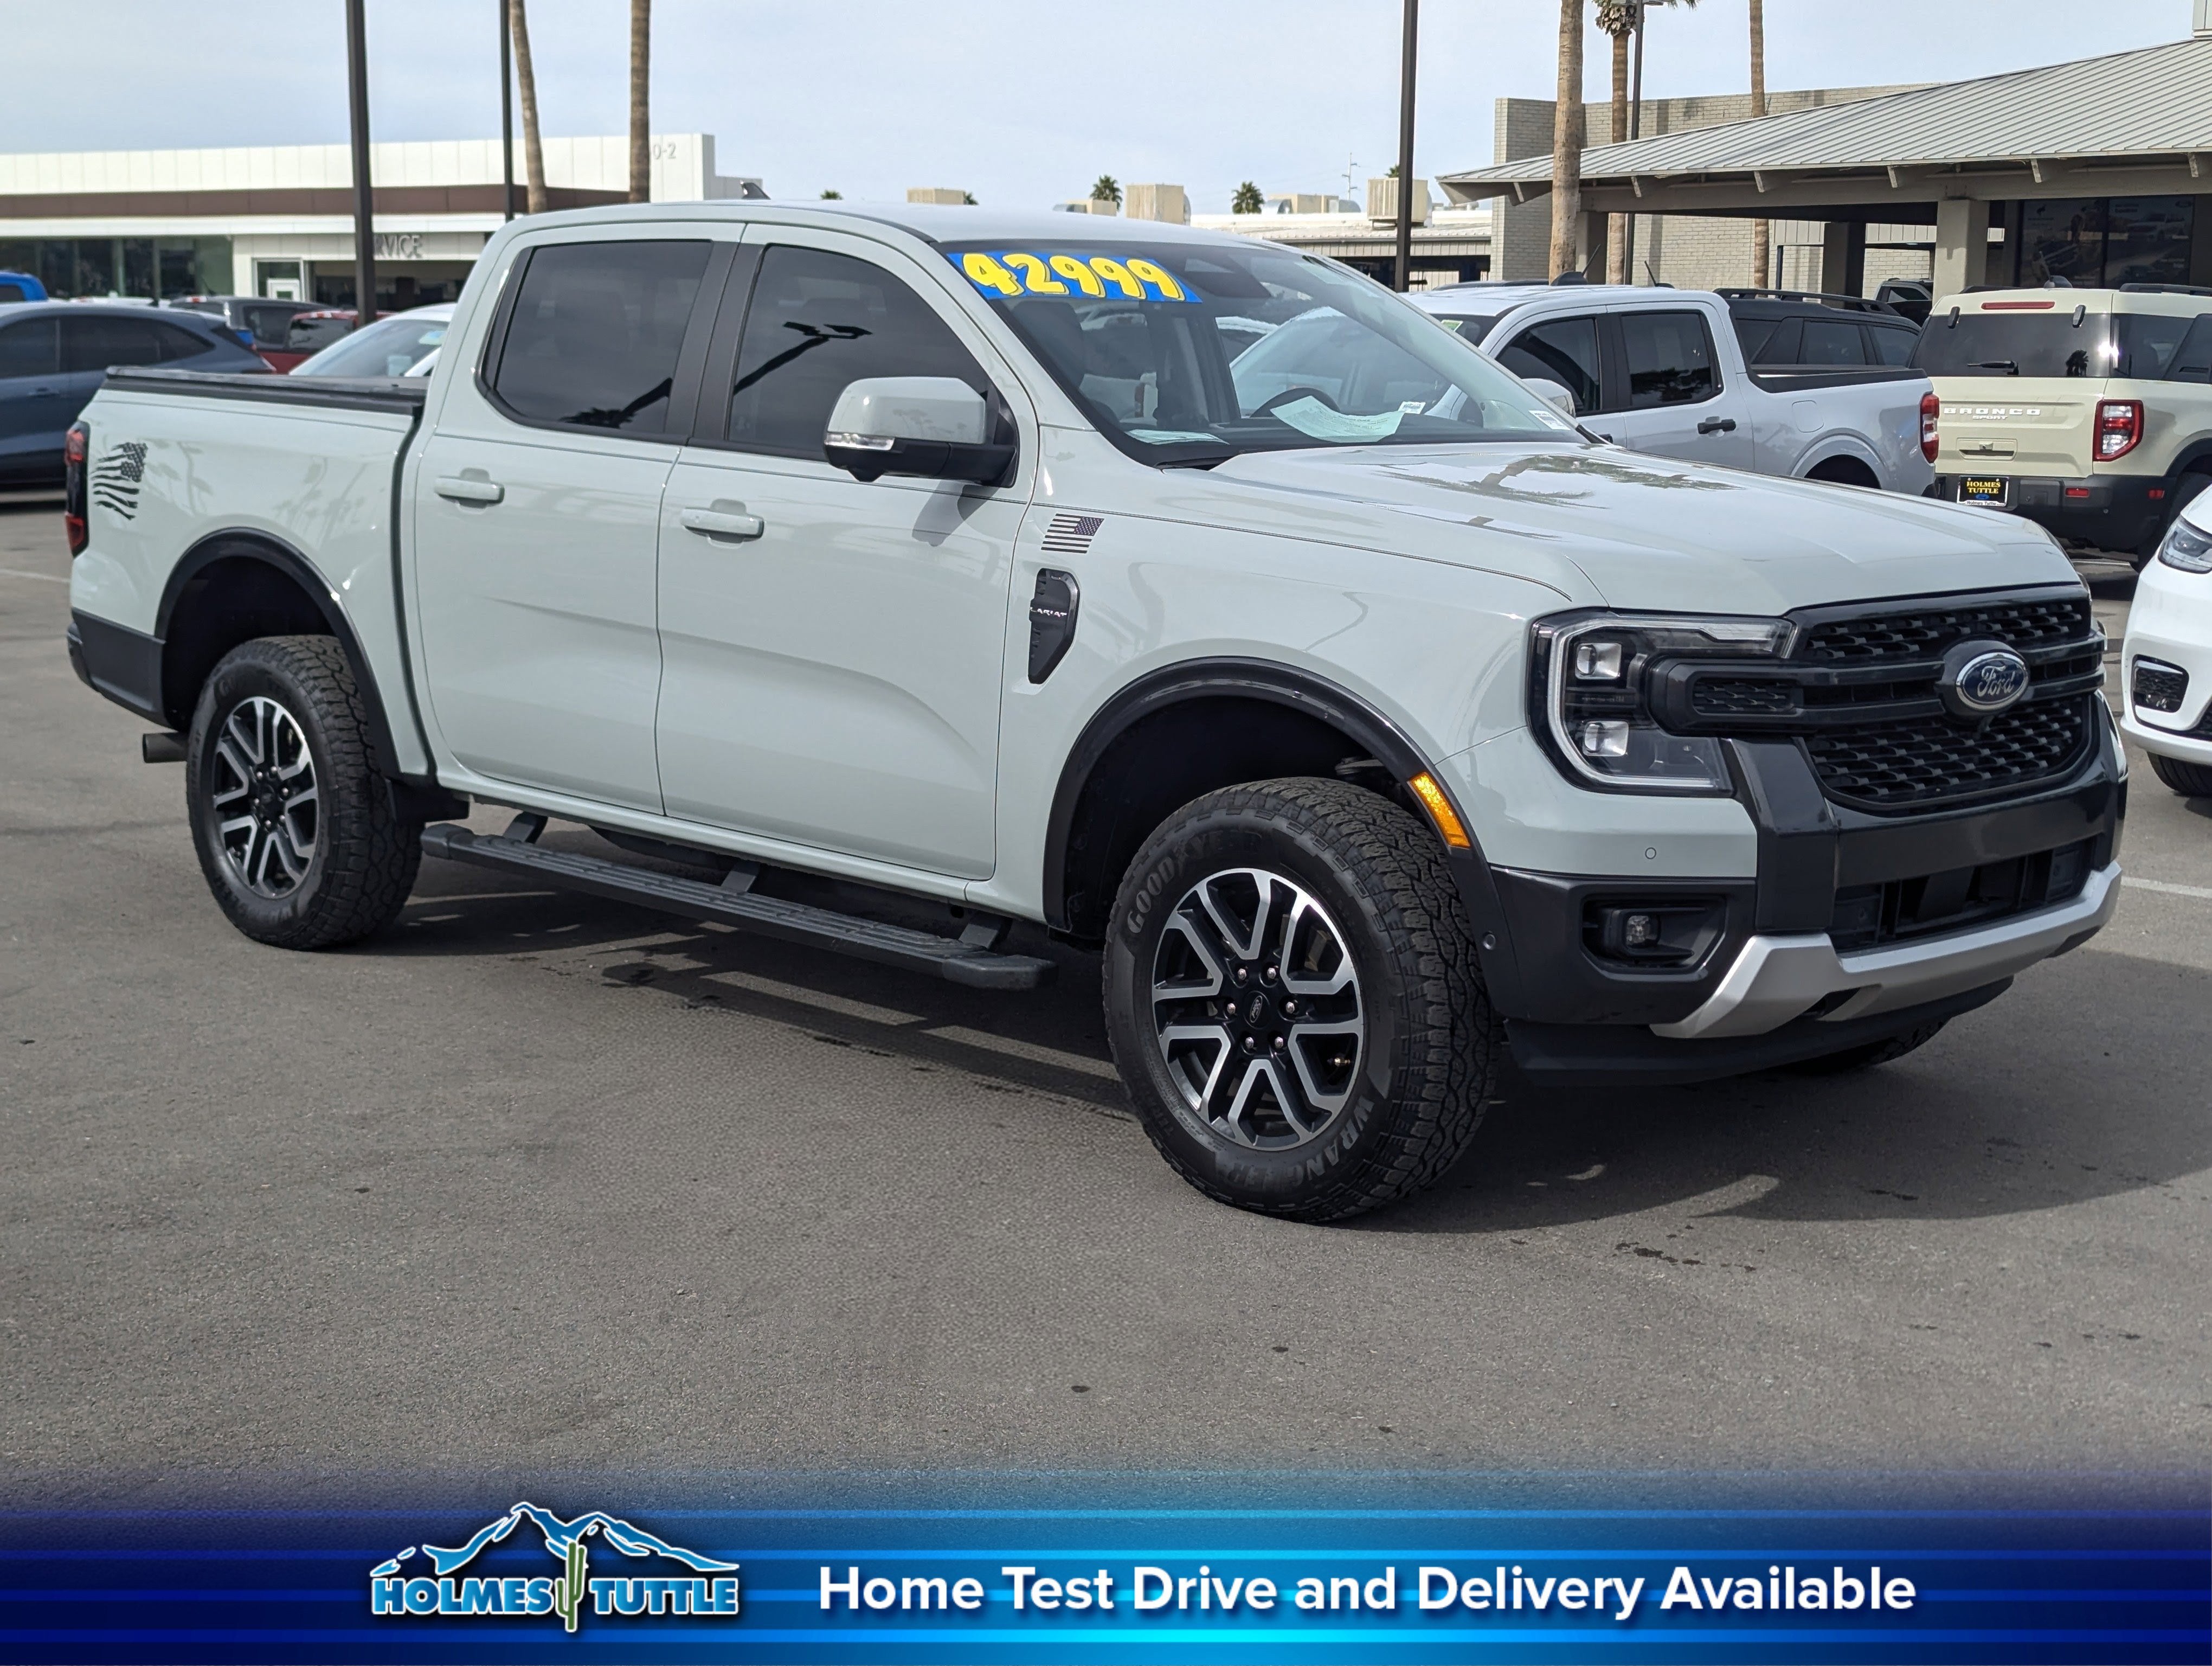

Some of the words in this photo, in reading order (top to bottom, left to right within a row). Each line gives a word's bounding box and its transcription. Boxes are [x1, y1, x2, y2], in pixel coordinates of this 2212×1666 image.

[963, 253, 1185, 300] 42999
[1944, 407, 2041, 415] BRONCO
[1030, 607, 1067, 617] LARIAT
[1977, 665, 2016, 697] Ford
